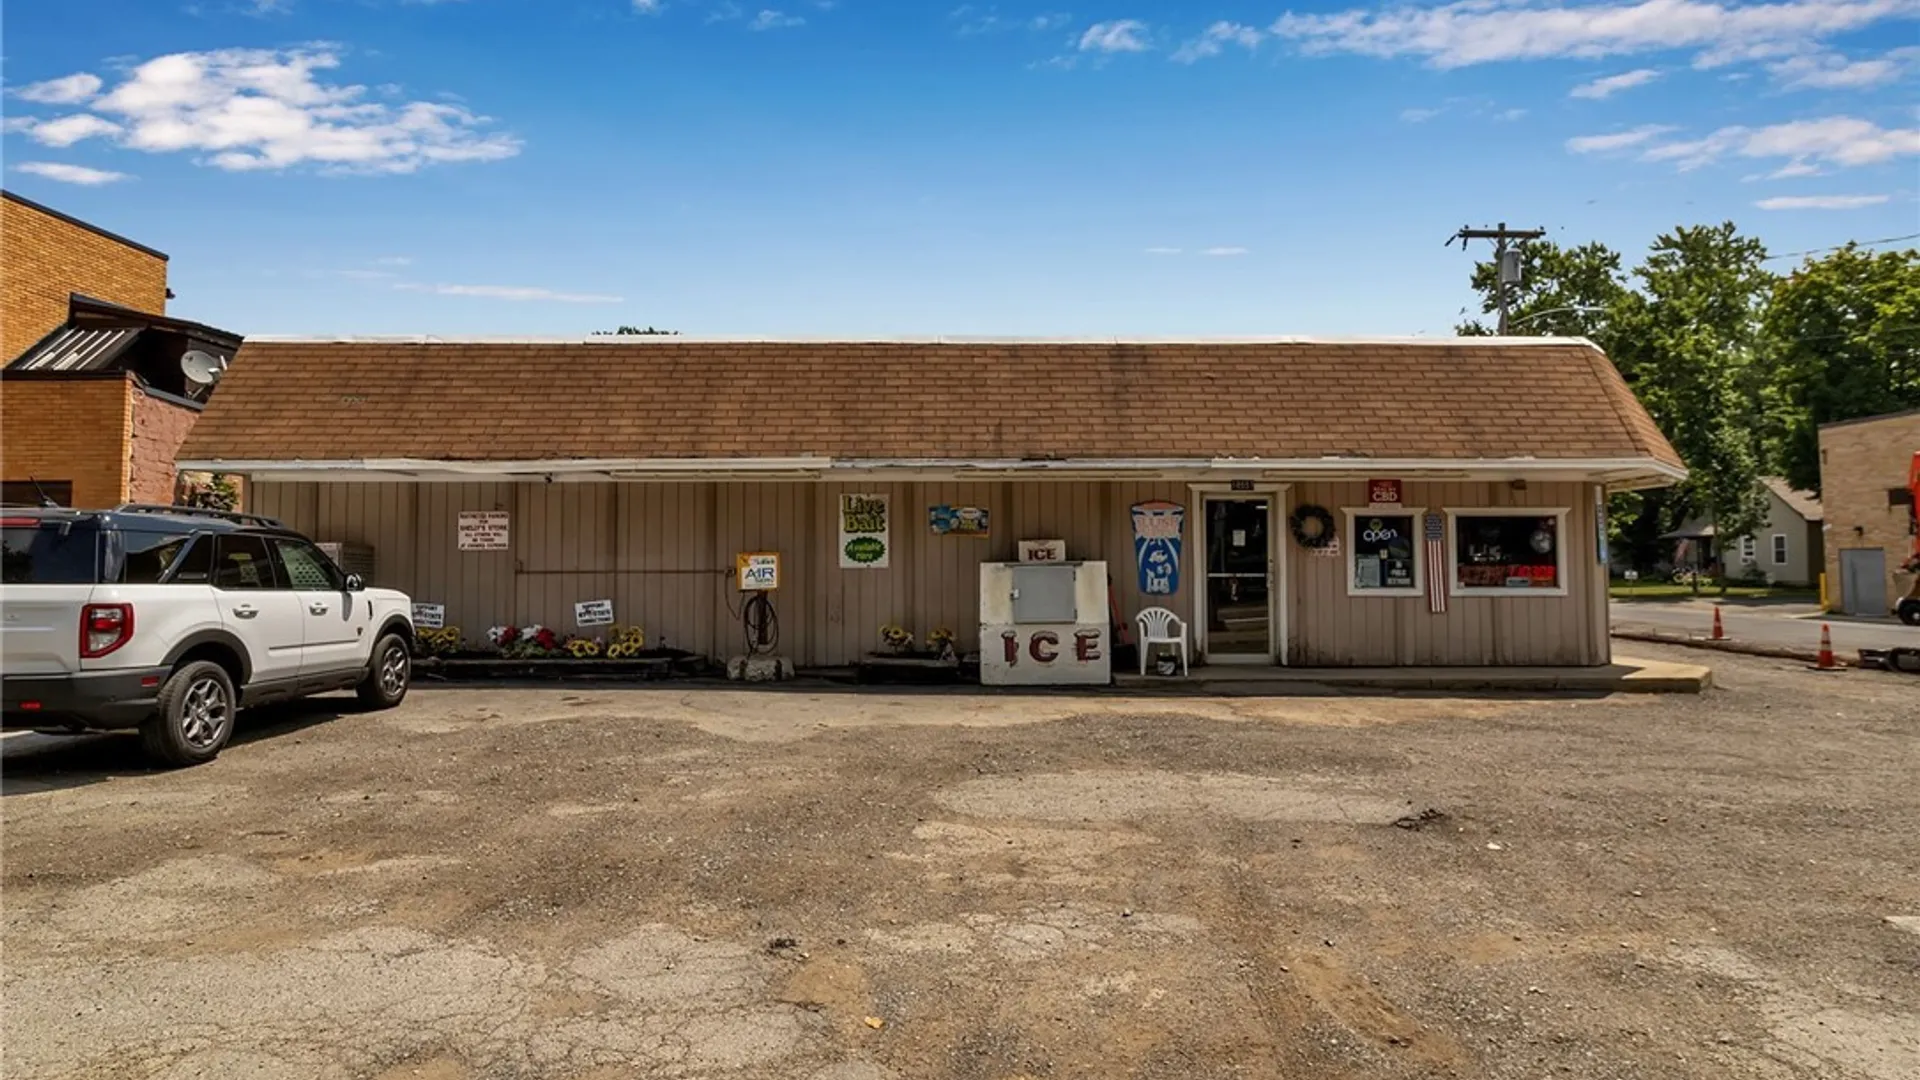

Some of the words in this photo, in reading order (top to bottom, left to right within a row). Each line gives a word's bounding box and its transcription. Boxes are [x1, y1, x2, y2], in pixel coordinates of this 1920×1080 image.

[1372, 491, 1398, 501] CBD
[842, 495, 885, 514] Live
[843, 513, 886, 533] Bait
[1028, 549, 1057, 561] ICE
[744, 567, 775, 579] AIR
[1001, 629, 1102, 668] ICE
